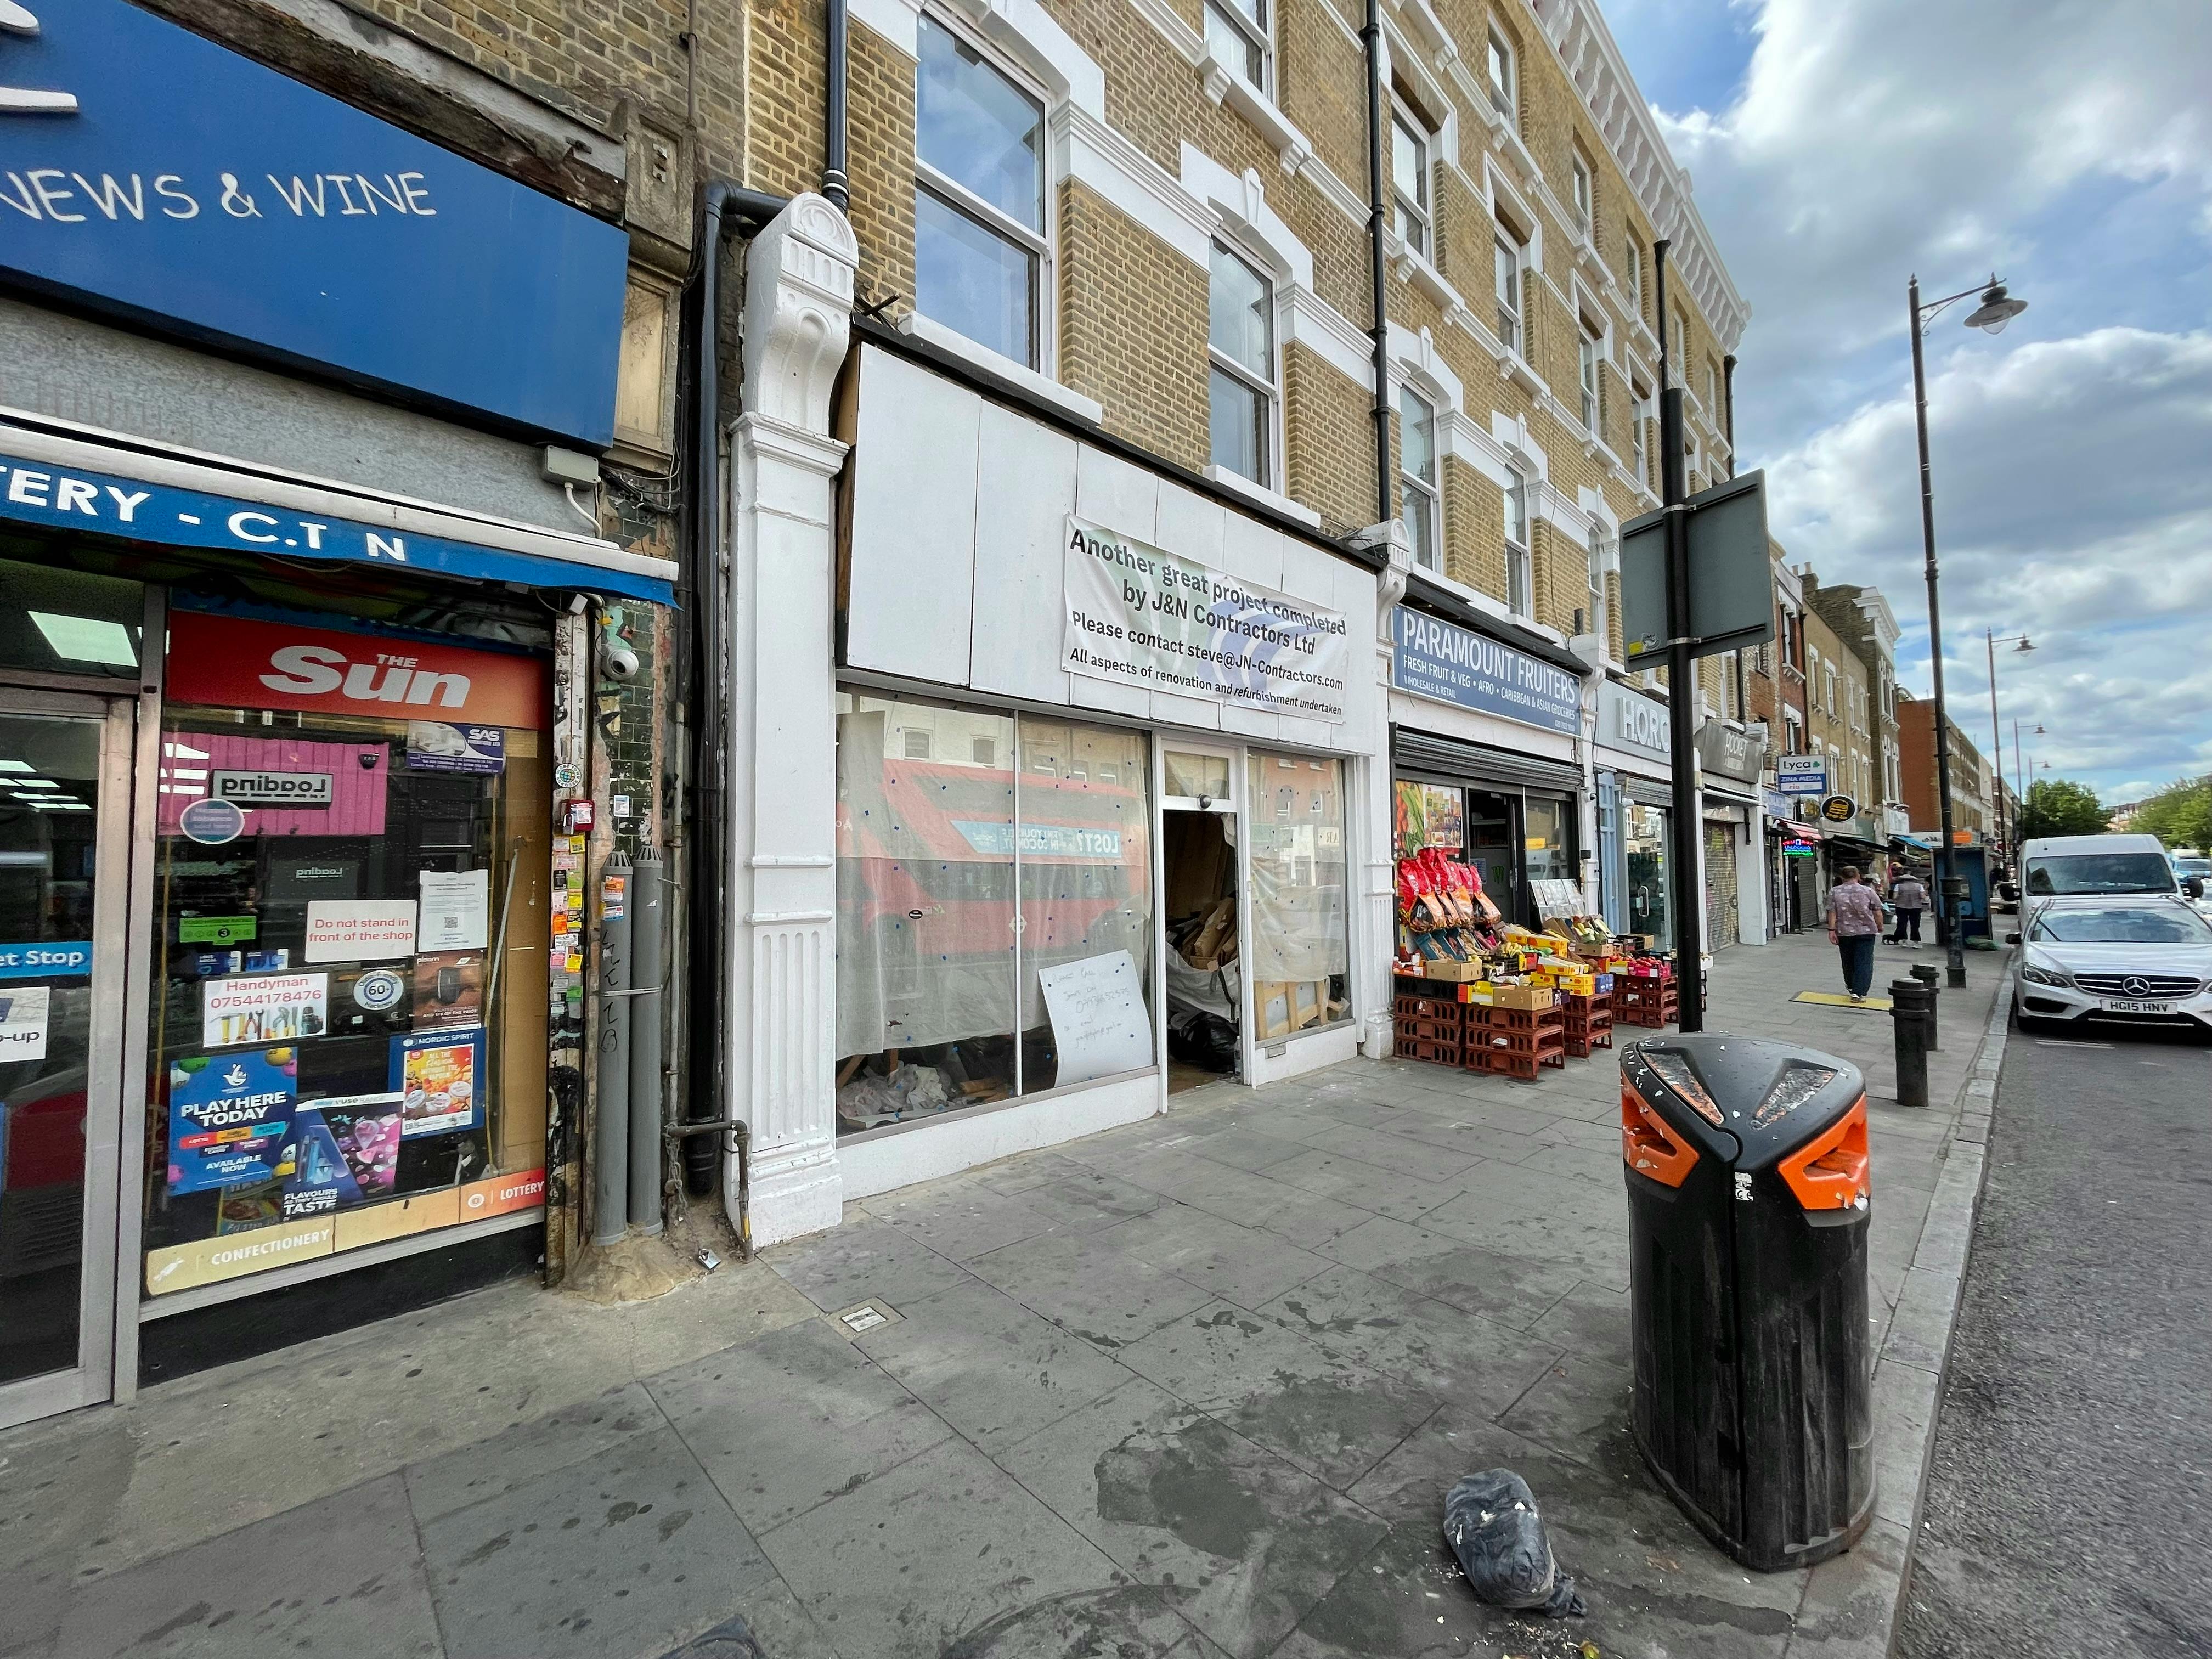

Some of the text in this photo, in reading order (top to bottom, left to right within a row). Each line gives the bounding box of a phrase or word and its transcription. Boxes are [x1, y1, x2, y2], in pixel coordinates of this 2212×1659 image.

[0, 168, 437, 222] NEWS & WINE
[0, 465, 151, 522] ERY
[1070, 528, 1346, 636] Another great project completed
[1123, 579, 1316, 655] by J&N Contractors Ltd
[1073, 610, 1343, 690] Please contact steve@JN-Contractors.com
[1403, 611, 1575, 704] PARAMOUNT FRUITERS
[376, 653, 419, 668] THE
[259, 645, 471, 708] Sun
[1070, 648, 1342, 716] All aspects of renovation and refurbishment undertaken
[1403, 654, 1576, 720] FRESH FRUIT & VEG AFRO CARIBBEAN & ASIAN GROCERIES
[1404, 675, 1457, 699] WHOLESALE & RETAIL
[469, 729, 500, 742] SAS
[1784, 761, 1811, 770] Lyca
[315, 917, 409, 928] Do not stand in
[309, 930, 413, 942] front of the shop
[25, 950, 84, 967] Stop
[226, 978, 308, 992] Handyman
[211, 990, 322, 1008] 07544178476
[2109, 1001, 2169, 1012] HG15 HNV
[419, 1032, 475, 1045] NORDIC SPIRIT
[181, 1091, 287, 1117] PLAY HERE
[198, 1105, 269, 1127] TODAY
[205, 1154, 262, 1170] AVAILABLE
[221, 1163, 247, 1173] NOW
[284, 1188, 338, 1201] FLAVOURS
[500, 1181, 545, 1201] LOTTERY
[283, 1199, 337, 1216] TASTE
[211, 1228, 330, 1266] CONFECTIONERY
